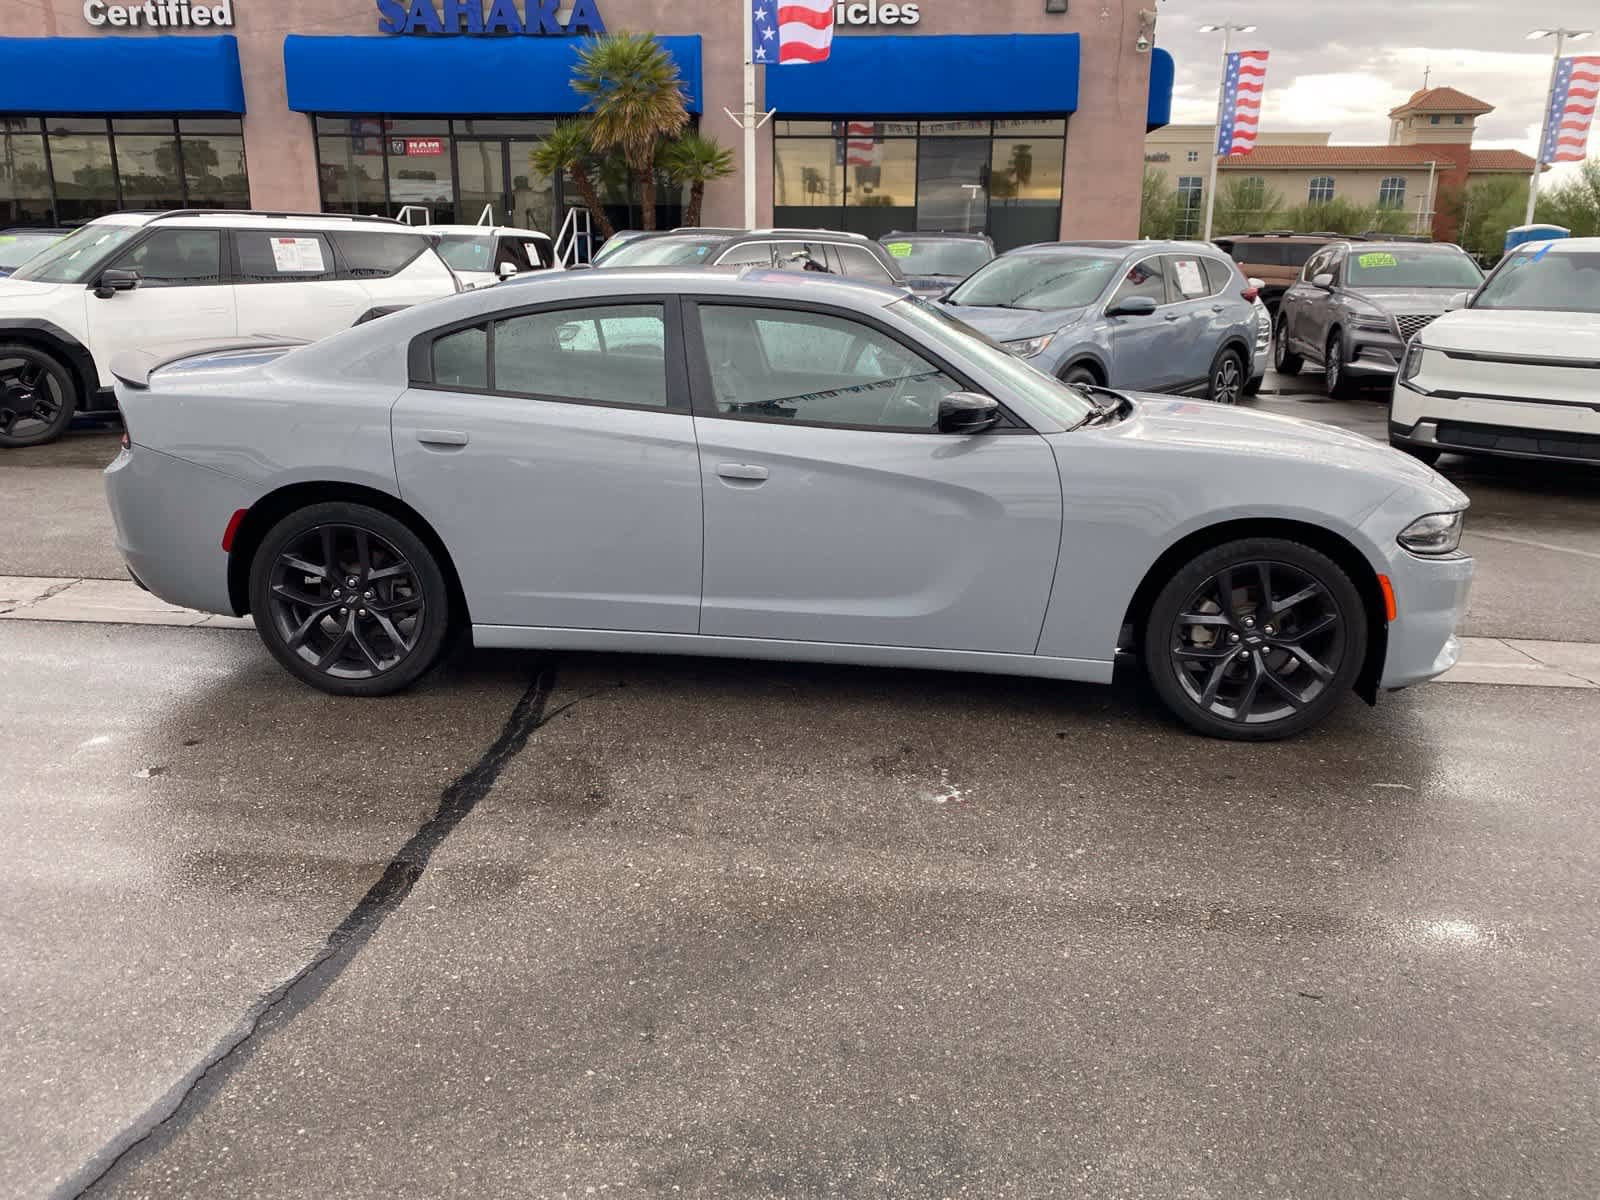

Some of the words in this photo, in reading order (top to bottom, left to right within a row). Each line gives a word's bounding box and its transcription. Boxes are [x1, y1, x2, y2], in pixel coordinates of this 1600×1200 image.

[83, 0, 233, 26] Certified
[377, 0, 607, 33] SAHARA
[832, 0, 920, 25] icles
[408, 140, 441, 150] RAM
